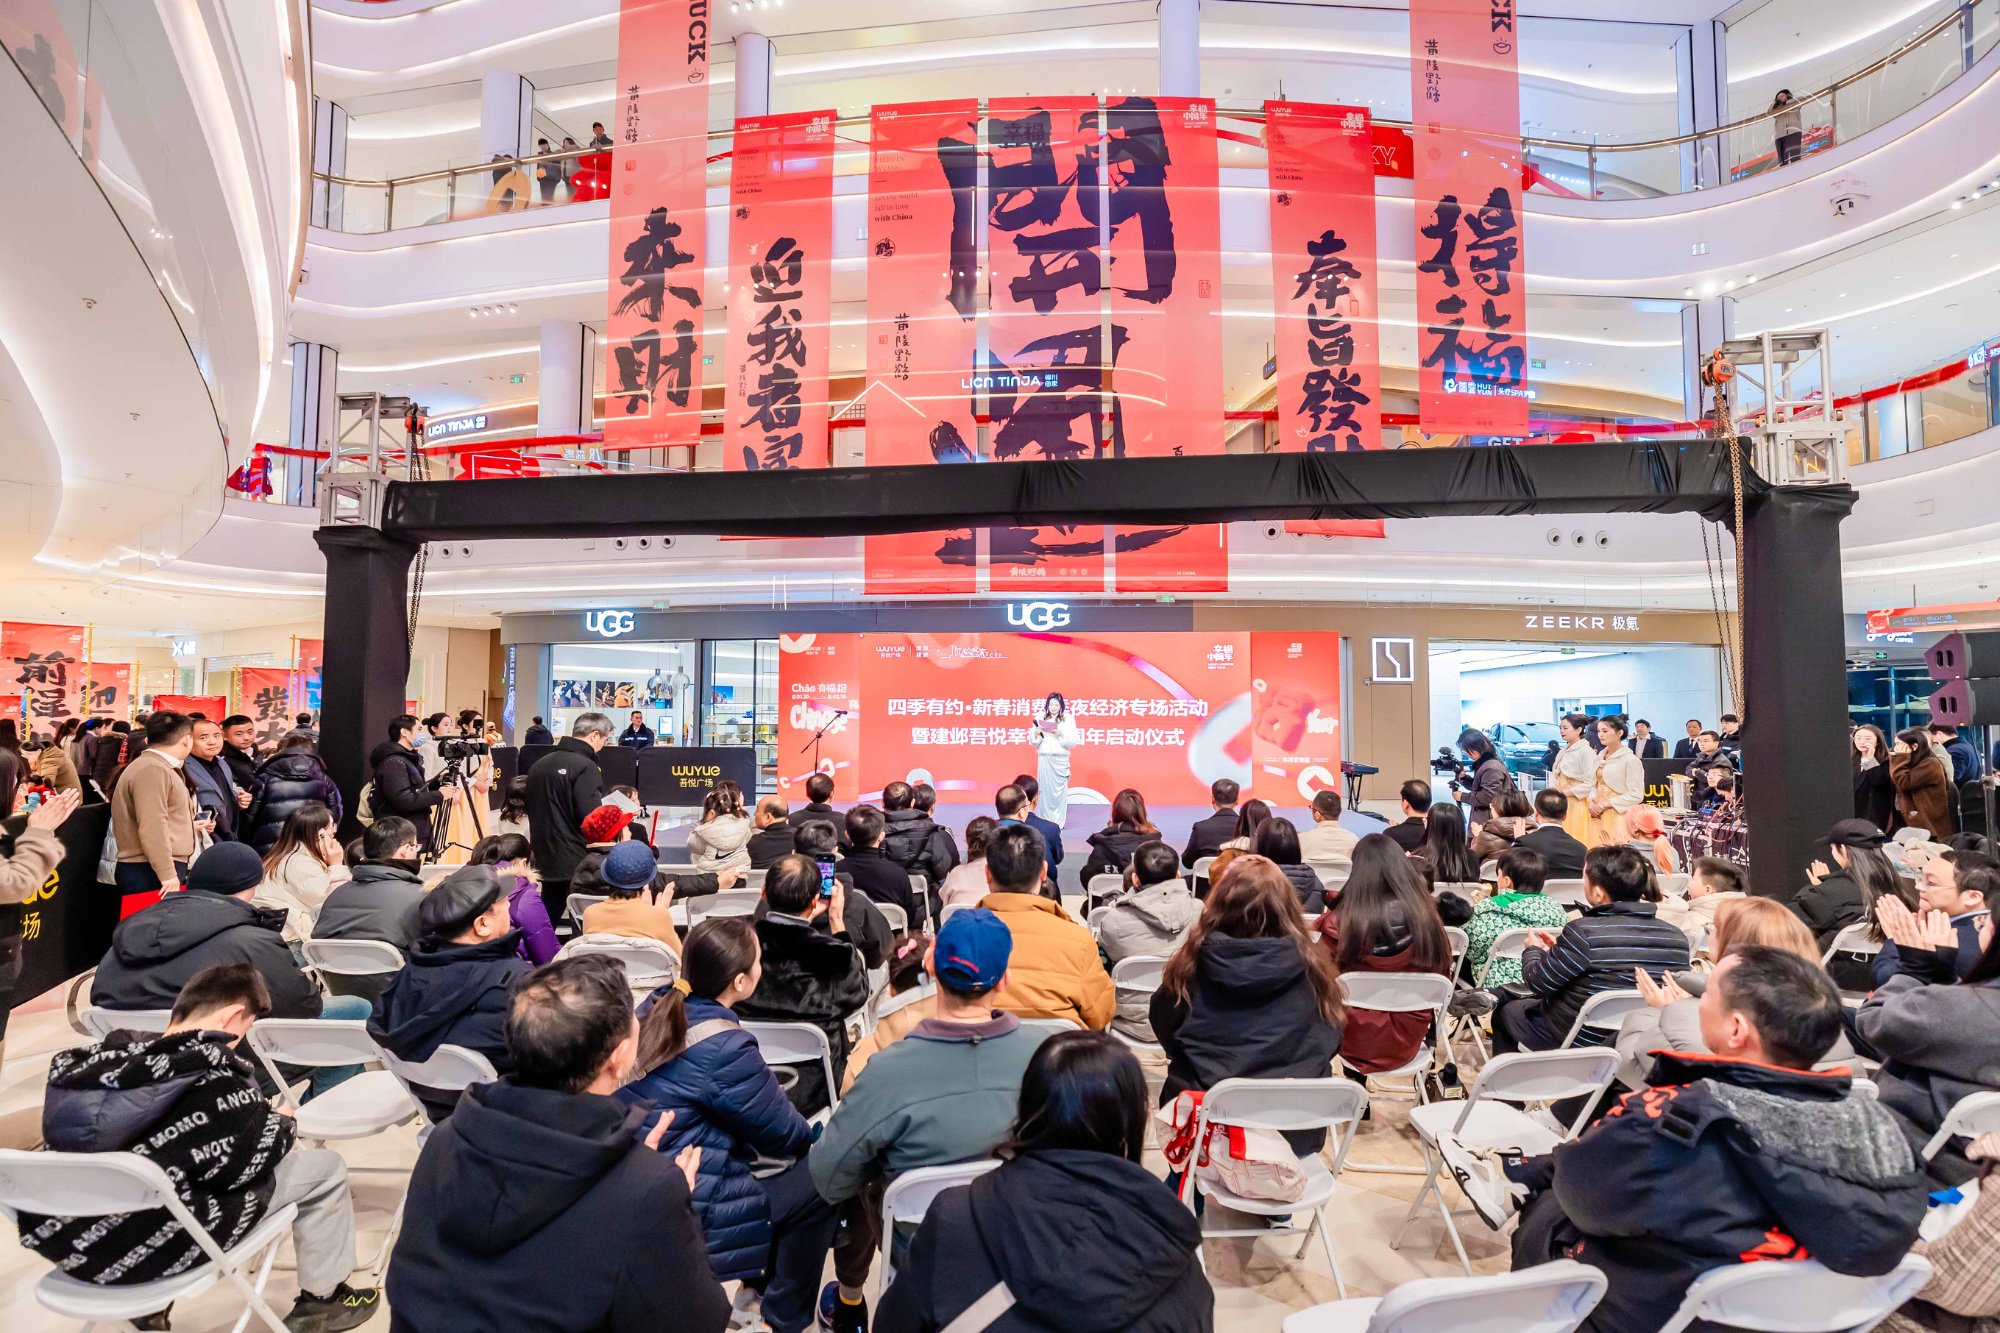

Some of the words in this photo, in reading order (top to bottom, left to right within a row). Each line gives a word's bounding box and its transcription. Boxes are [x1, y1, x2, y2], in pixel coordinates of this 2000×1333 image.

[892, 213, 913, 221] China
[586, 610, 635, 638] UGG
[1007, 601, 1071, 632] UGG
[1525, 615, 1606, 629] ZEEKR
[1612, 615, 1640, 631] 极氪
[680, 777, 714, 788] 吾悦广场
[149, 1111, 209, 1150] MOMO
